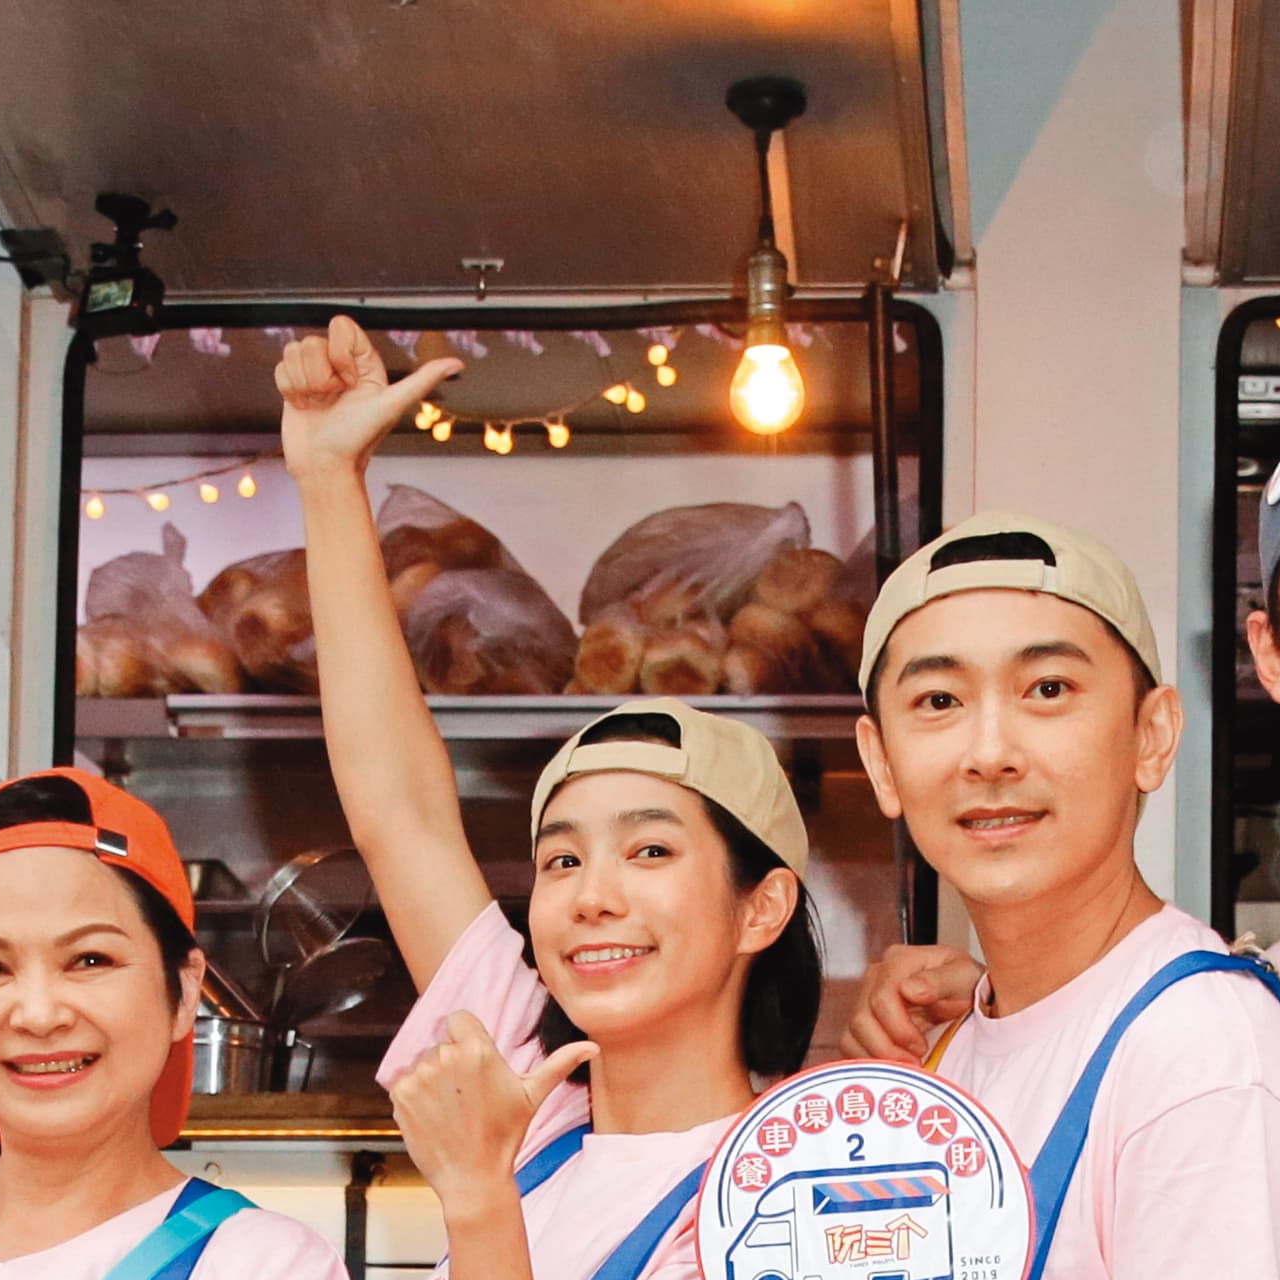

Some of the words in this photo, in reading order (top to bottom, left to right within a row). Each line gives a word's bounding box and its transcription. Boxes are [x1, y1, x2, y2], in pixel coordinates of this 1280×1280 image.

[733, 1085, 984, 1190] 餐車環島發大財
[846, 1133, 865, 1162] 2
